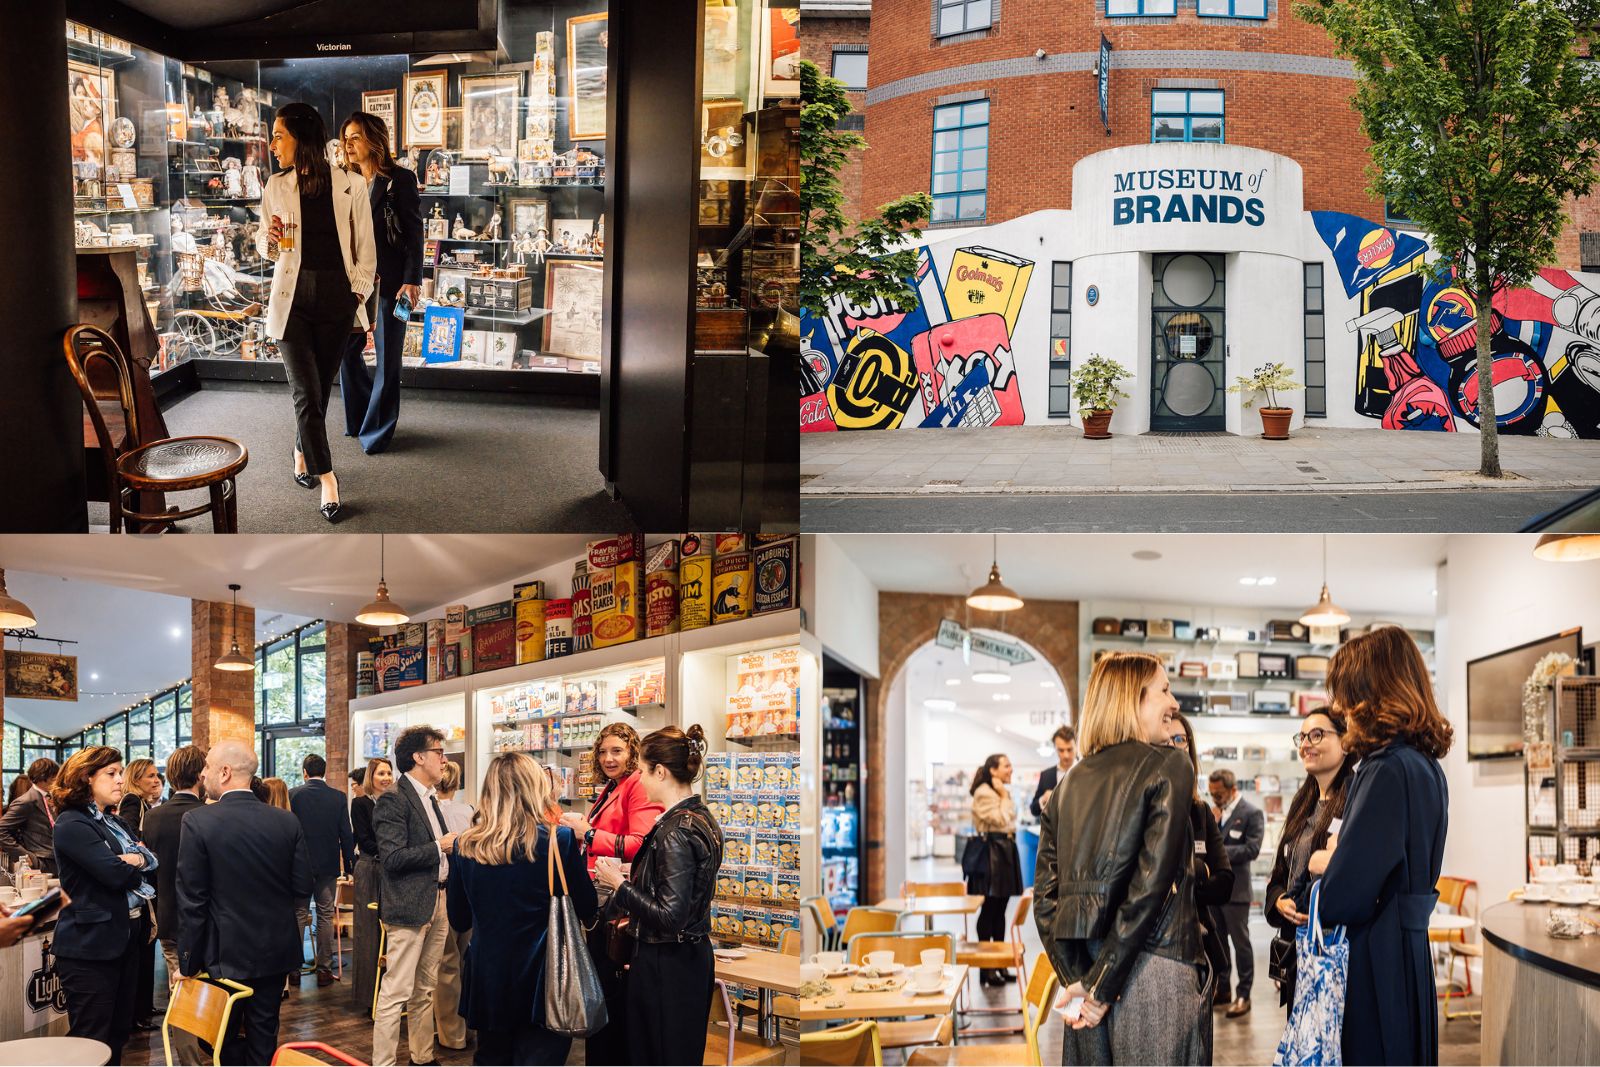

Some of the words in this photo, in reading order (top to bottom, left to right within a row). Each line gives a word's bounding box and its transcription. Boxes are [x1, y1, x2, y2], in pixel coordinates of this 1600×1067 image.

[316, 43, 352, 51] Victorian
[369, 103, 391, 111] CAUTION
[1114, 169, 1243, 193] MUSEUM
[1248, 168, 1268, 194] of
[1113, 194, 1265, 227] BRANDS
[757, 546, 790, 565] CADBURY'S
[593, 582, 613, 598] CORN
[593, 596, 613, 611] FLAKES
[401, 651, 422, 672] SOLVO
[528, 695, 542, 709] Tide
[1030, 711, 1055, 725] GIFT
[743, 909, 765, 917] RICICLES
[771, 912, 793, 920] RICICLES
